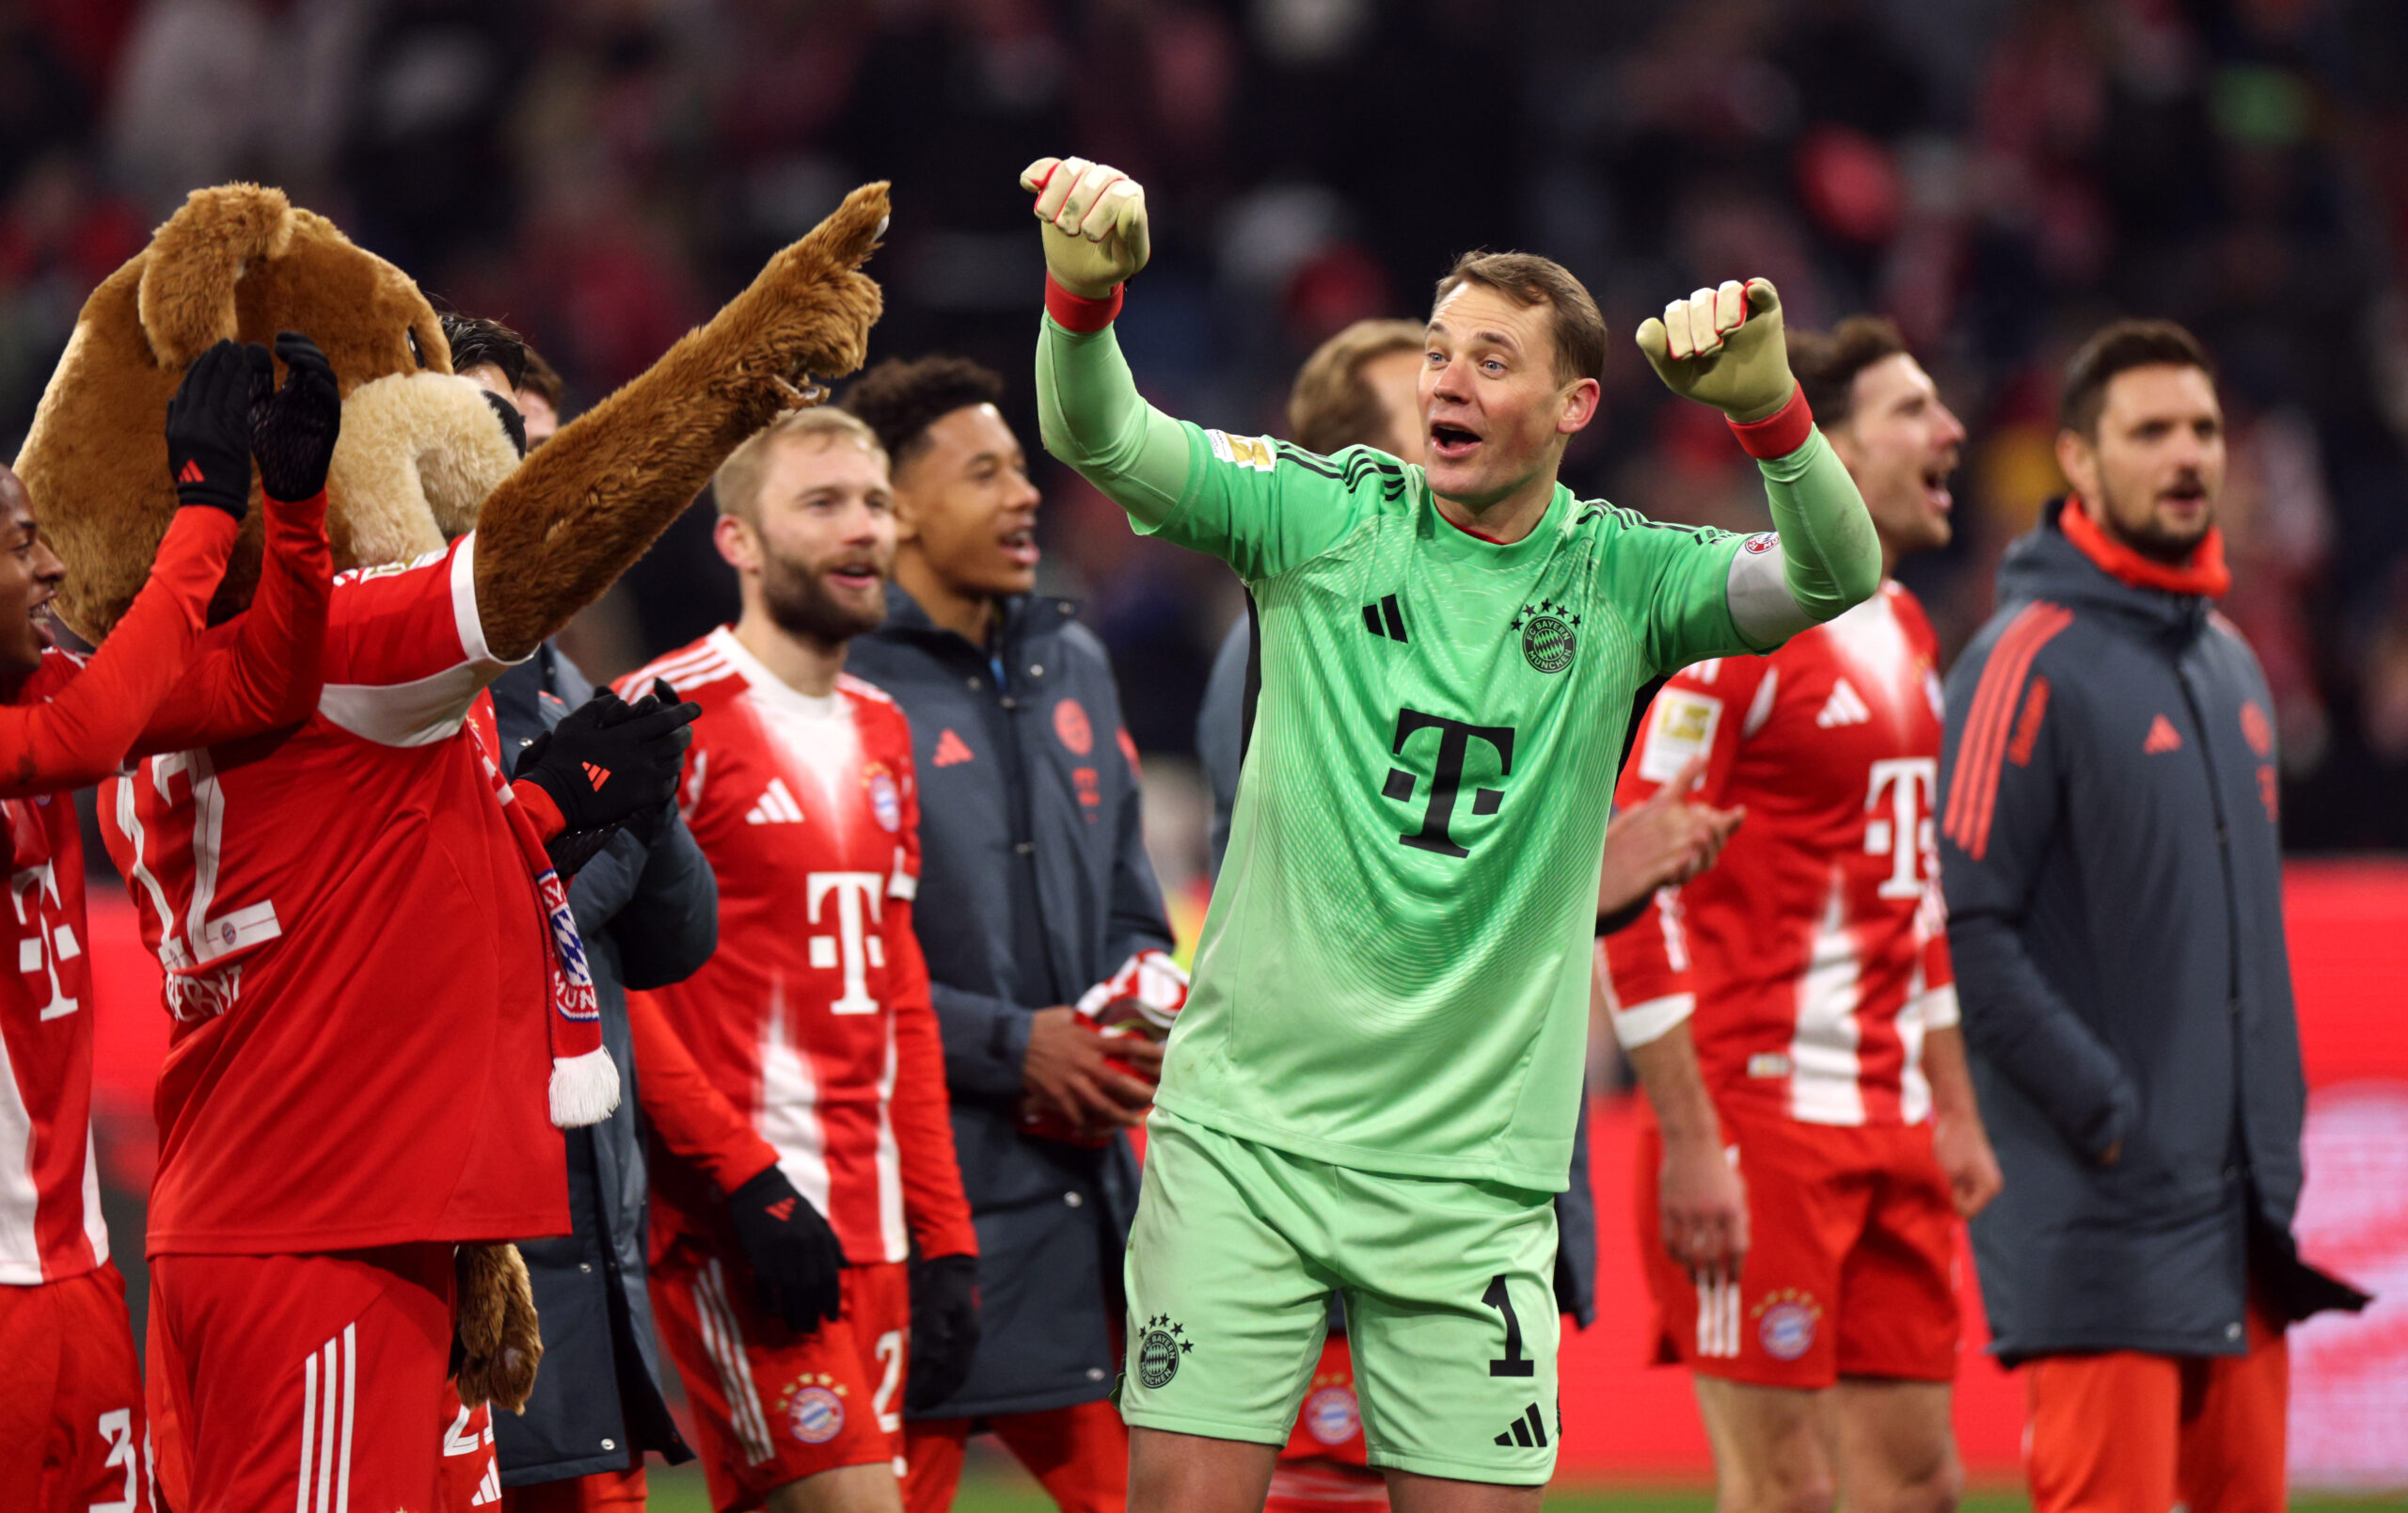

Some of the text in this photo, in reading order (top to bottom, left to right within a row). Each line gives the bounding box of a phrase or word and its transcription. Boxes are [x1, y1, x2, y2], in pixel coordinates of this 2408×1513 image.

[1527, 620, 1571, 641] FC BAYERN
[1382, 708, 1515, 858] T
[1863, 757, 1938, 899] T
[807, 871, 885, 1014] T
[1151, 1334, 1176, 1360] BAYERN
[1481, 1274, 1534, 1377] 1
